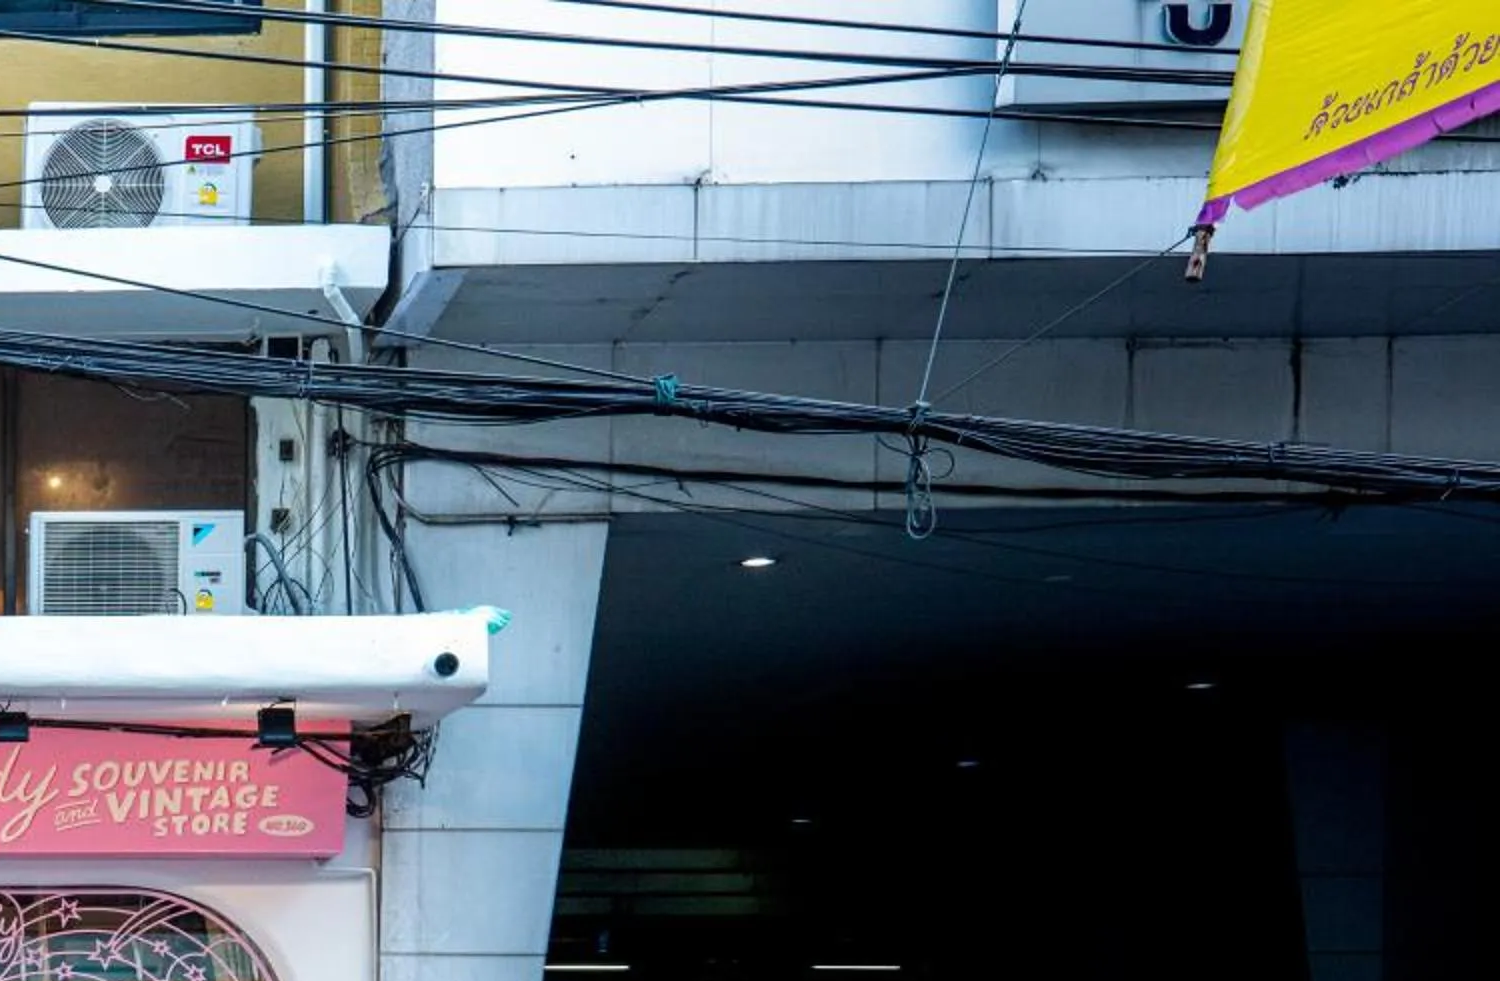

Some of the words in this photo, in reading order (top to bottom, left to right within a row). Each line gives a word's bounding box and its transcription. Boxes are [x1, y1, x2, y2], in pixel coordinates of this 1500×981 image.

[191, 143, 225, 156] TCL
[67, 760, 250, 798] SOUVENIR
[54, 800, 99, 827] and
[106, 784, 280, 824] VINTAGE
[153, 811, 249, 837] STORE
